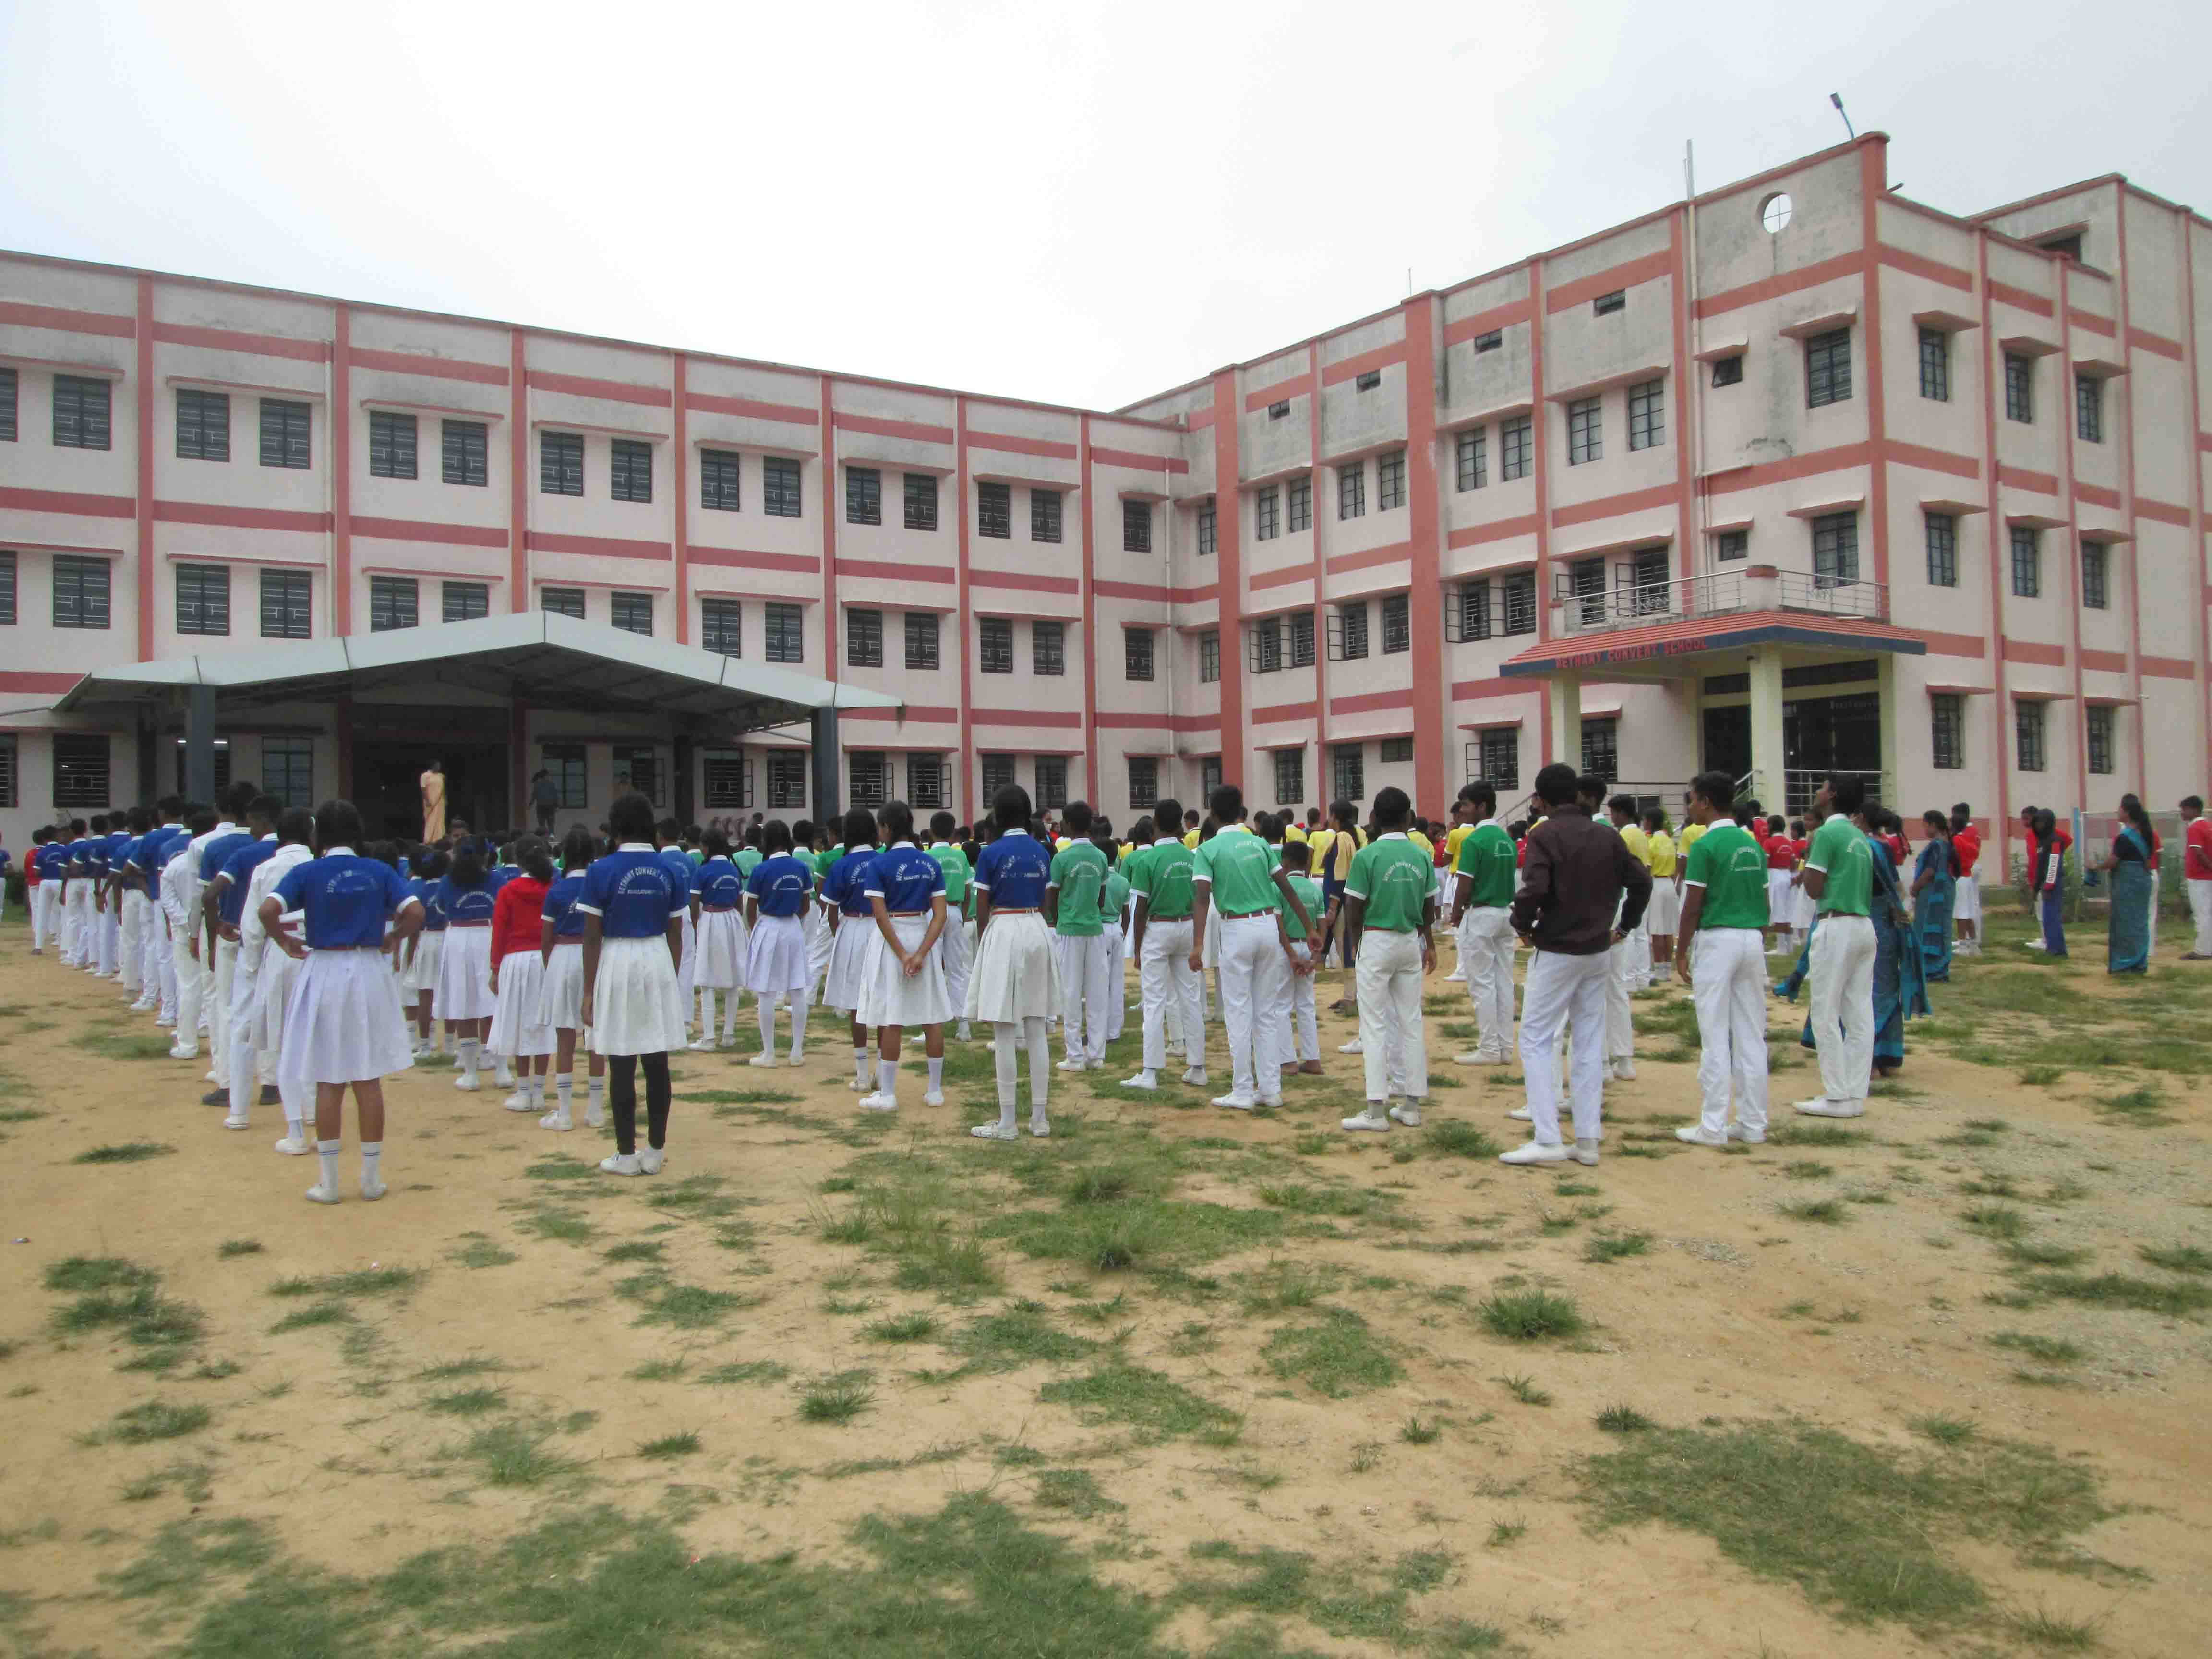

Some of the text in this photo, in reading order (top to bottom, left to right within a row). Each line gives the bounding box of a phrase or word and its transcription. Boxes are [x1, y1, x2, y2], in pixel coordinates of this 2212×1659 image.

[1555, 637, 1709, 669] BETHANY CONVENT SCHOOL
